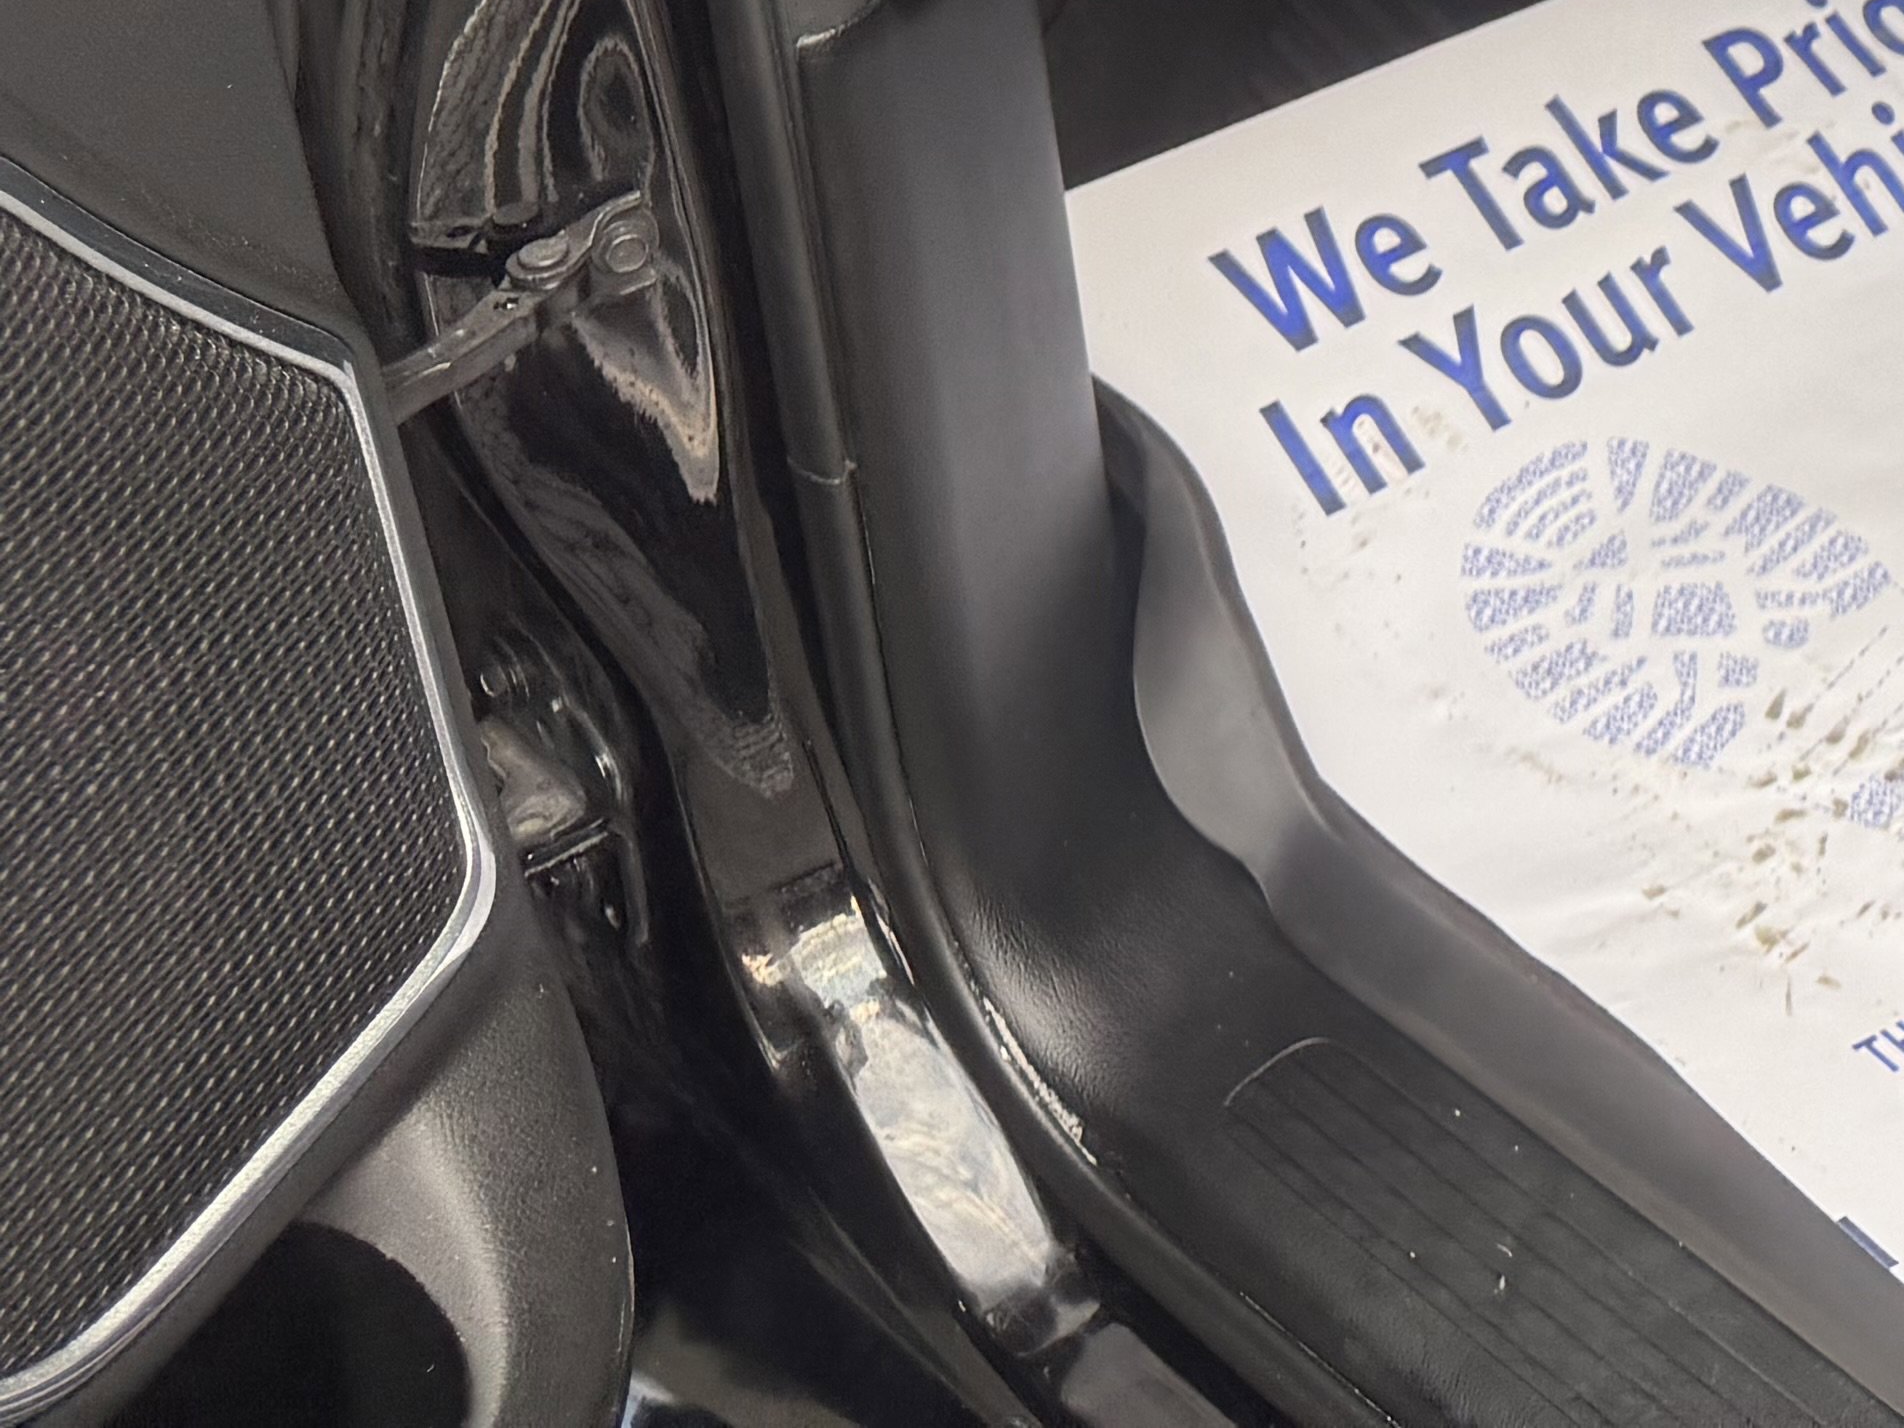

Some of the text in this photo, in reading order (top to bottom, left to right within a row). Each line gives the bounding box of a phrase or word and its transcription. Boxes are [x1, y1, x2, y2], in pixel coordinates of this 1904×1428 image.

[1207, 204, 1443, 352] We
[1417, 89, 1720, 251] Take
[1258, 392, 1427, 517] In
[1396, 245, 1695, 432] Your
